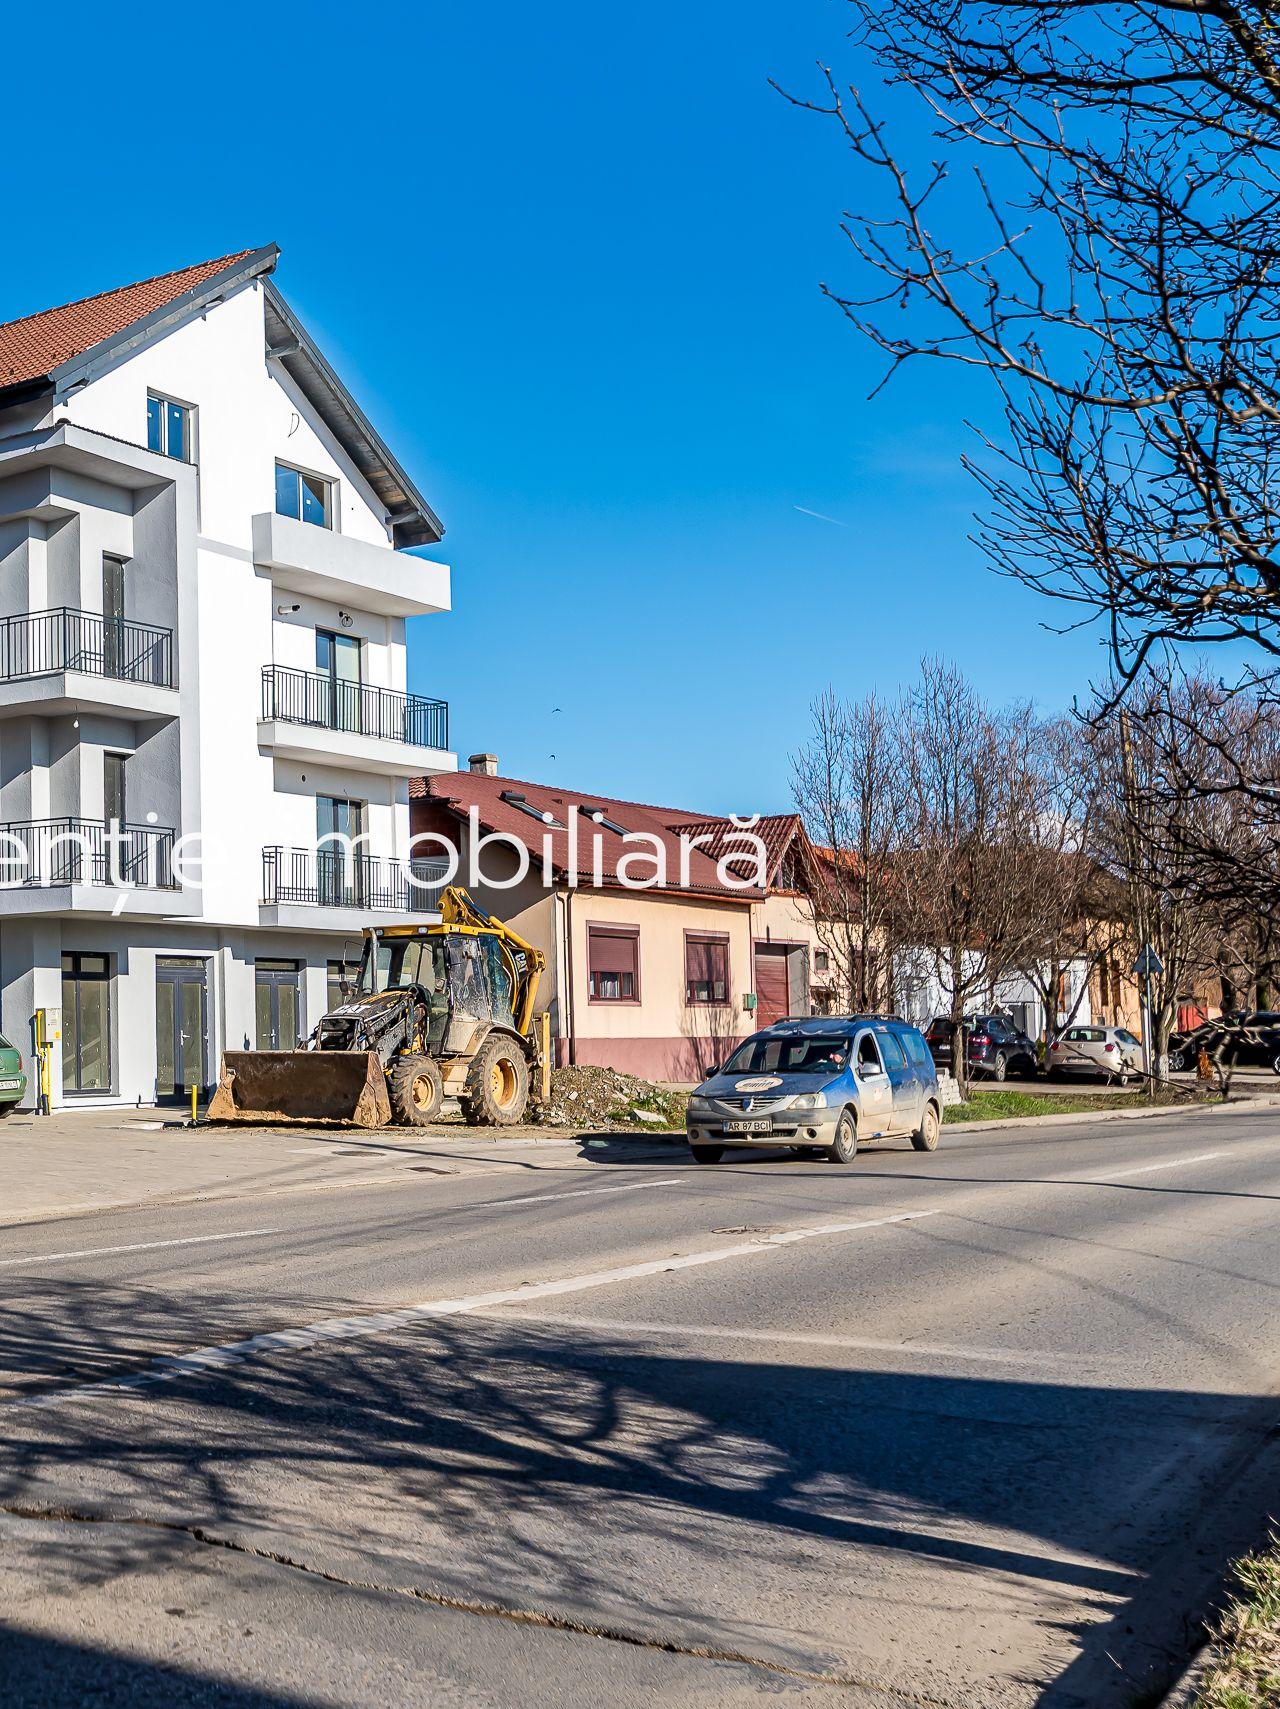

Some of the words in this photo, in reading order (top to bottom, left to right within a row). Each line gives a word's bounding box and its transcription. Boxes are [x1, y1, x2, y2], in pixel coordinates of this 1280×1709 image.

[728, 1120, 741, 1131] AR
[742, 1120, 752, 1131] 87
[754, 1120, 768, 1131] BCI
